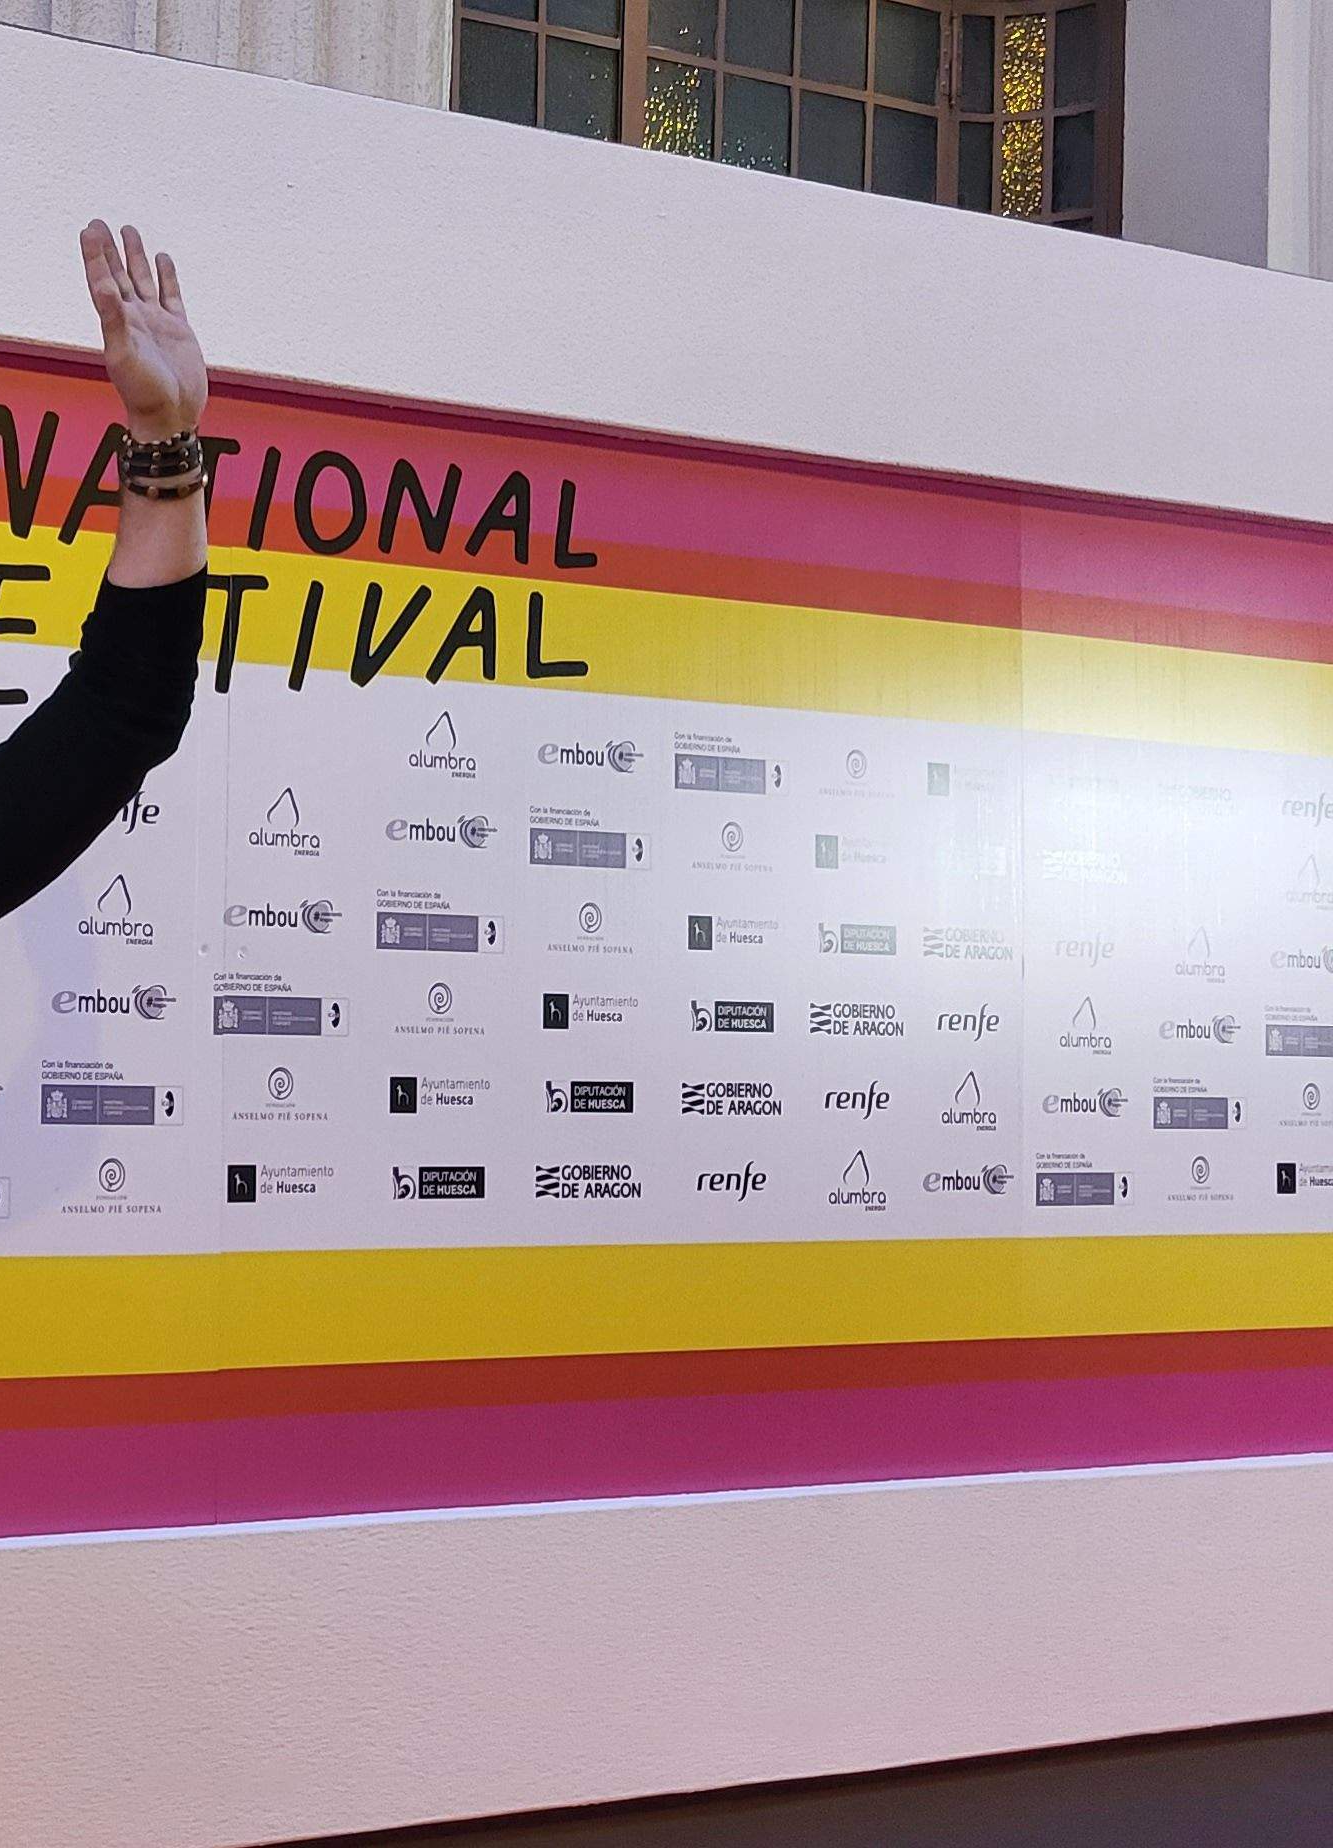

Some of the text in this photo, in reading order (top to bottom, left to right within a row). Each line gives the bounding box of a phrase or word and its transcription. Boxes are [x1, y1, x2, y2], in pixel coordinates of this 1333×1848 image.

[408, 749, 477, 771] alumbra
[538, 742, 605, 766] embou
[385, 815, 456, 843] embou
[248, 827, 321, 850] alumbra
[223, 903, 298, 928] embou
[78, 916, 154, 939] alumbra
[1174, 960, 1226, 978] alumbra
[51, 989, 130, 1014] embou
[572, 994, 639, 1010] Ayuntamiento
[572, 1009, 623, 1022] de Huesca
[717, 1004, 768, 1018] DIPUTACIÓN
[833, 1003, 896, 1019] GOBIERNO
[717, 1017, 768, 1030] DE HUESCA
[833, 1020, 905, 1037] DE ARAGON
[937, 1003, 1000, 1042] renfe
[1159, 1014, 1211, 1040] embou
[1059, 1031, 1112, 1049] alumbra
[420, 1077, 491, 1093] Ayuntamiento
[574, 1083, 626, 1097] DIPUTACIÓN
[706, 1082, 773, 1099] GOBIERNO
[420, 1092, 474, 1106] de Huesca
[574, 1098, 626, 1110] DE HUESCA
[706, 1099, 782, 1116] DE ARAGON
[824, 1080, 891, 1120] renfe
[1042, 1090, 1097, 1115] embou
[941, 1107, 997, 1125] alumbra
[260, 1164, 334, 1181] Ayuntamiento
[422, 1168, 477, 1182] DIPUTACIÓN
[561, 1164, 632, 1181] GOBIERNO
[696, 1160, 767, 1202] renfe
[922, 1166, 981, 1192] embou
[260, 1180, 316, 1194] de Huesca
[422, 1182, 477, 1196] DE HUESCA
[561, 1182, 642, 1199] DE ARAGON
[828, 1187, 887, 1206] alumbra
[61, 1204, 106, 1214] ANSELMO
[126, 1204, 162, 1214] SOPENA
